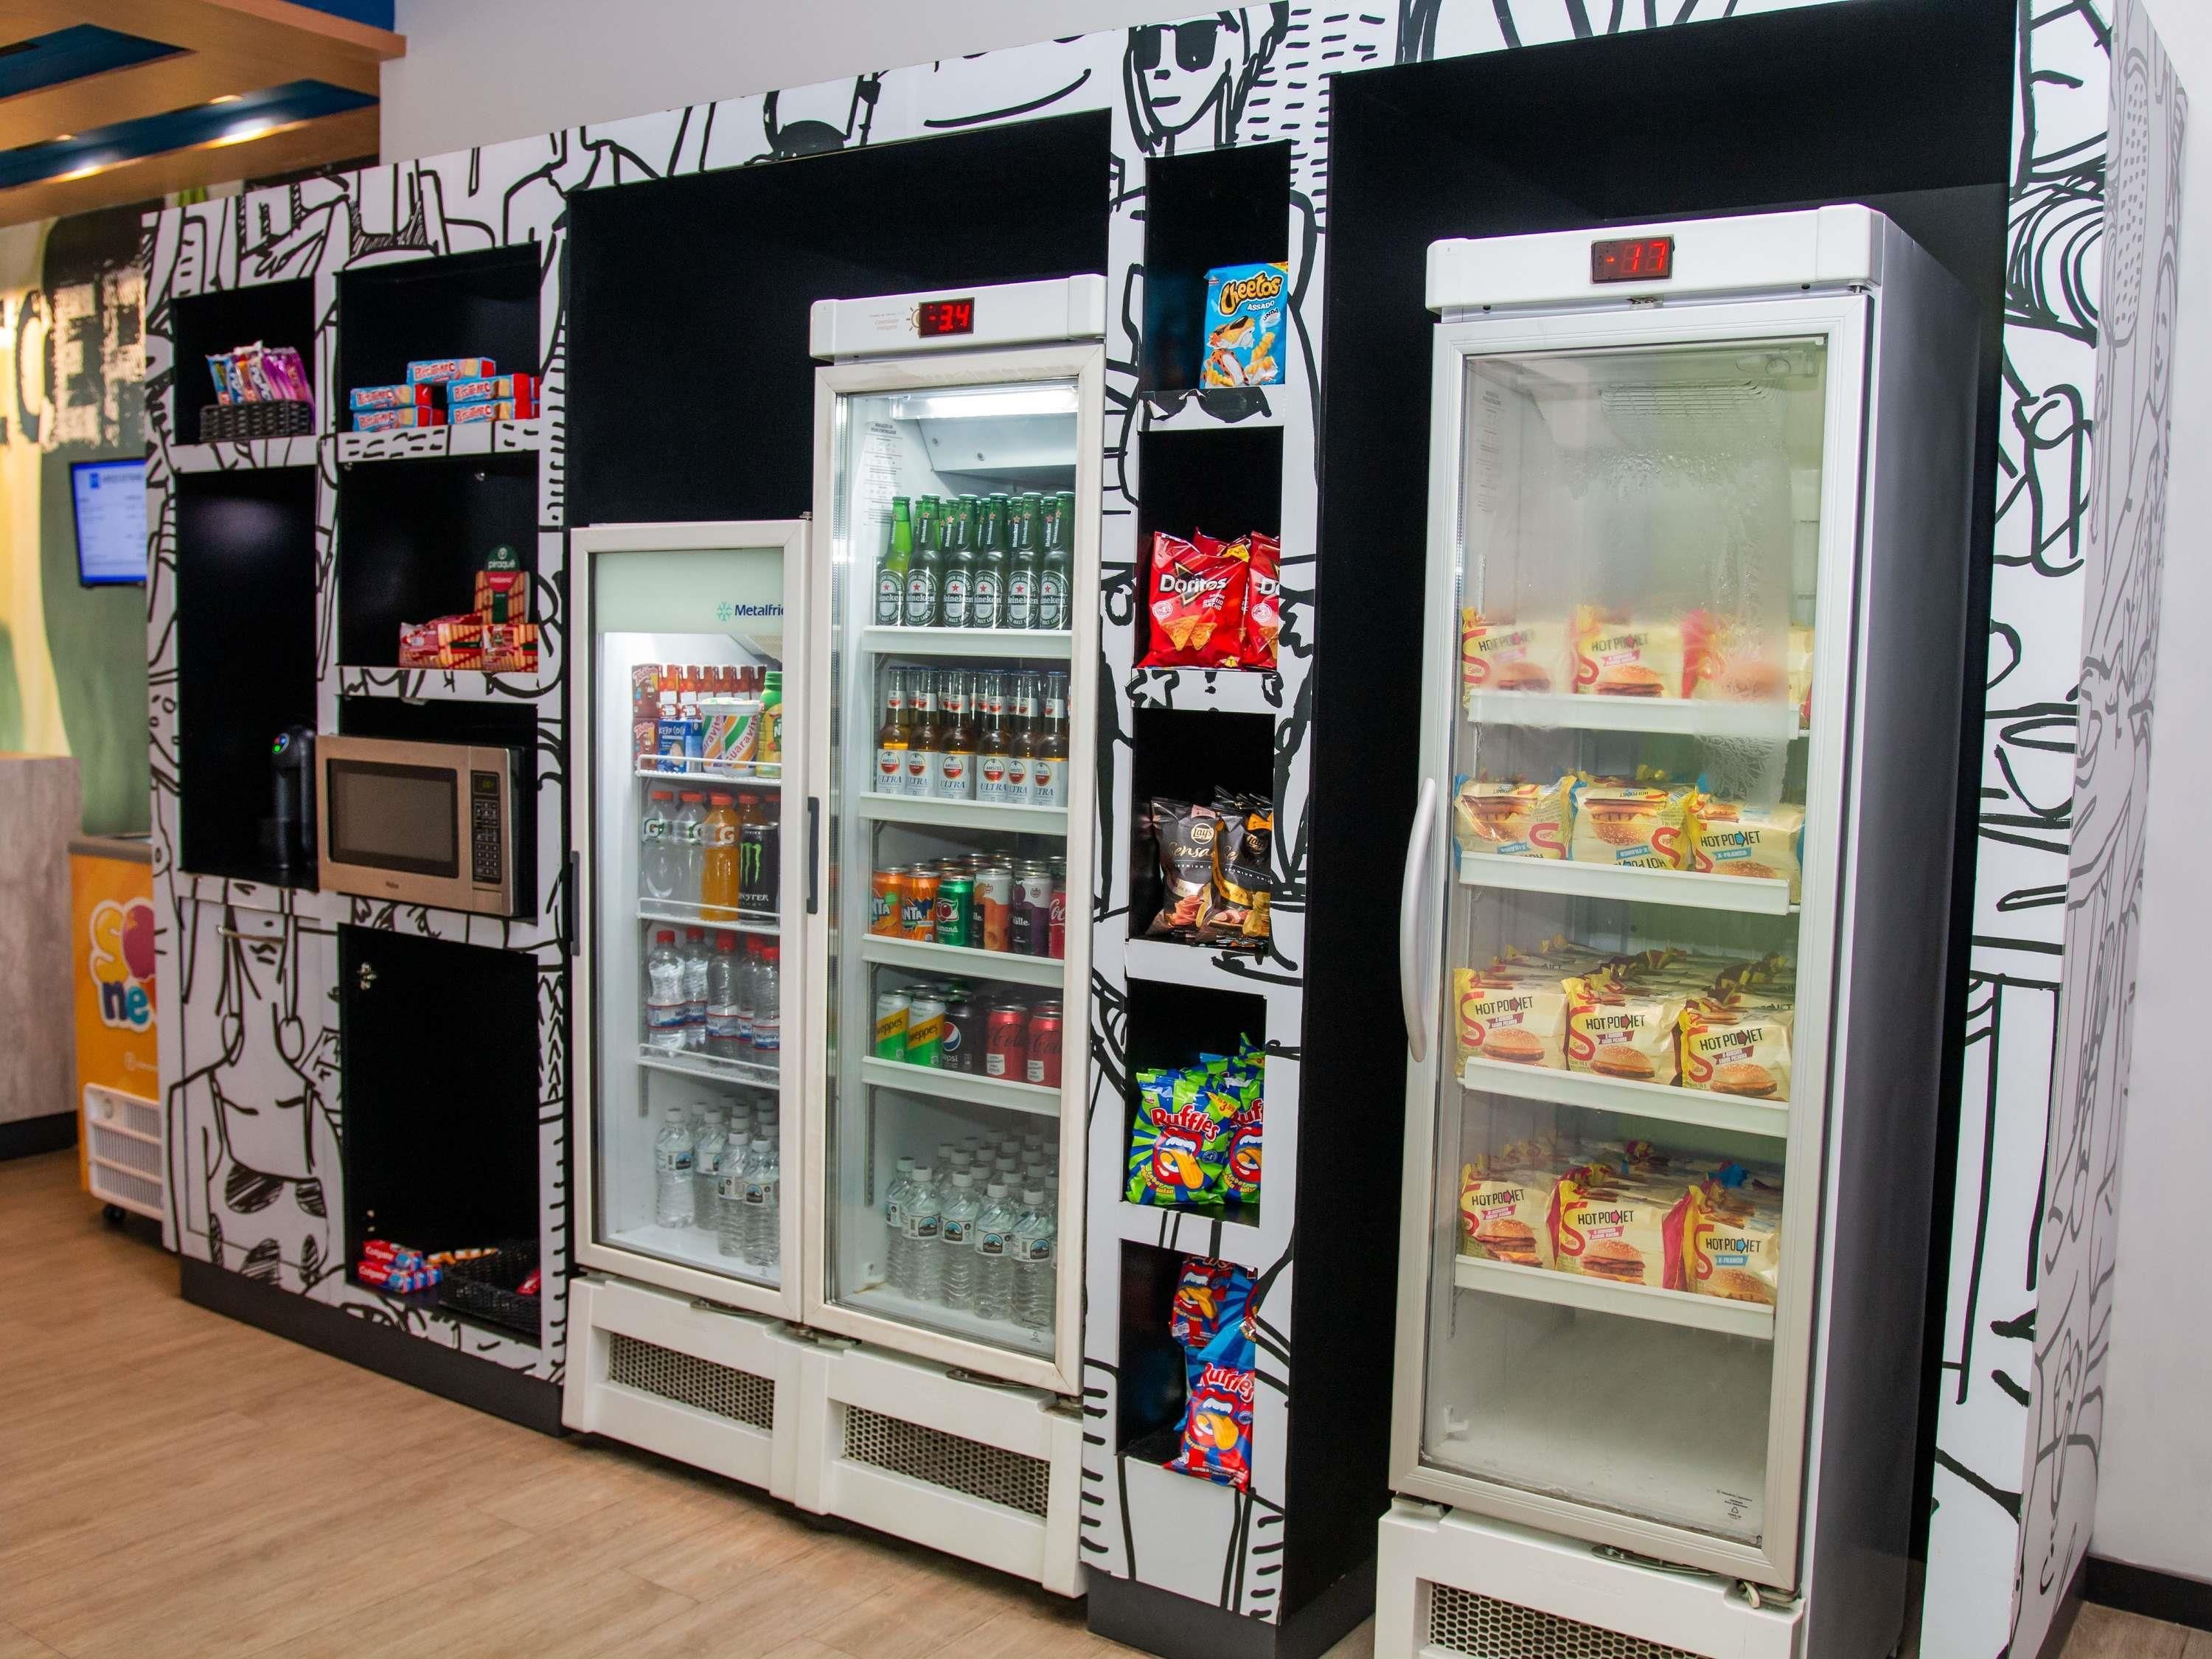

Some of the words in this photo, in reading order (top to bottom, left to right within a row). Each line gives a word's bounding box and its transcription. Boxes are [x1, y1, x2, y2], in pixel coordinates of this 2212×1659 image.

[1220, 272, 1283, 316] Cheetos
[1248, 300, 1275, 310] ASSADO
[1160, 574, 1227, 594] Doritos
[907, 593, 936, 602] eineken
[944, 594, 974, 603] eineken
[1008, 595, 1039, 605] eineken
[1700, 835, 1722, 848] HOT
[1169, 841, 1215, 858] Sensa
[873, 897, 891, 916] NTA
[901, 905, 924, 922] NTA
[1475, 1002, 1496, 1015] HOT
[1585, 1018, 1606, 1031] HOT
[1699, 1037, 1722, 1051] HOT
[1150, 1104, 1221, 1142] Ruffles
[1472, 1194, 1492, 1206] HOT
[1578, 1212, 1597, 1225] HOT
[1705, 1238, 1724, 1251] HOT
[358, 1266, 388, 1281] Colgate
[1197, 1362, 1254, 1402] Ruffles
